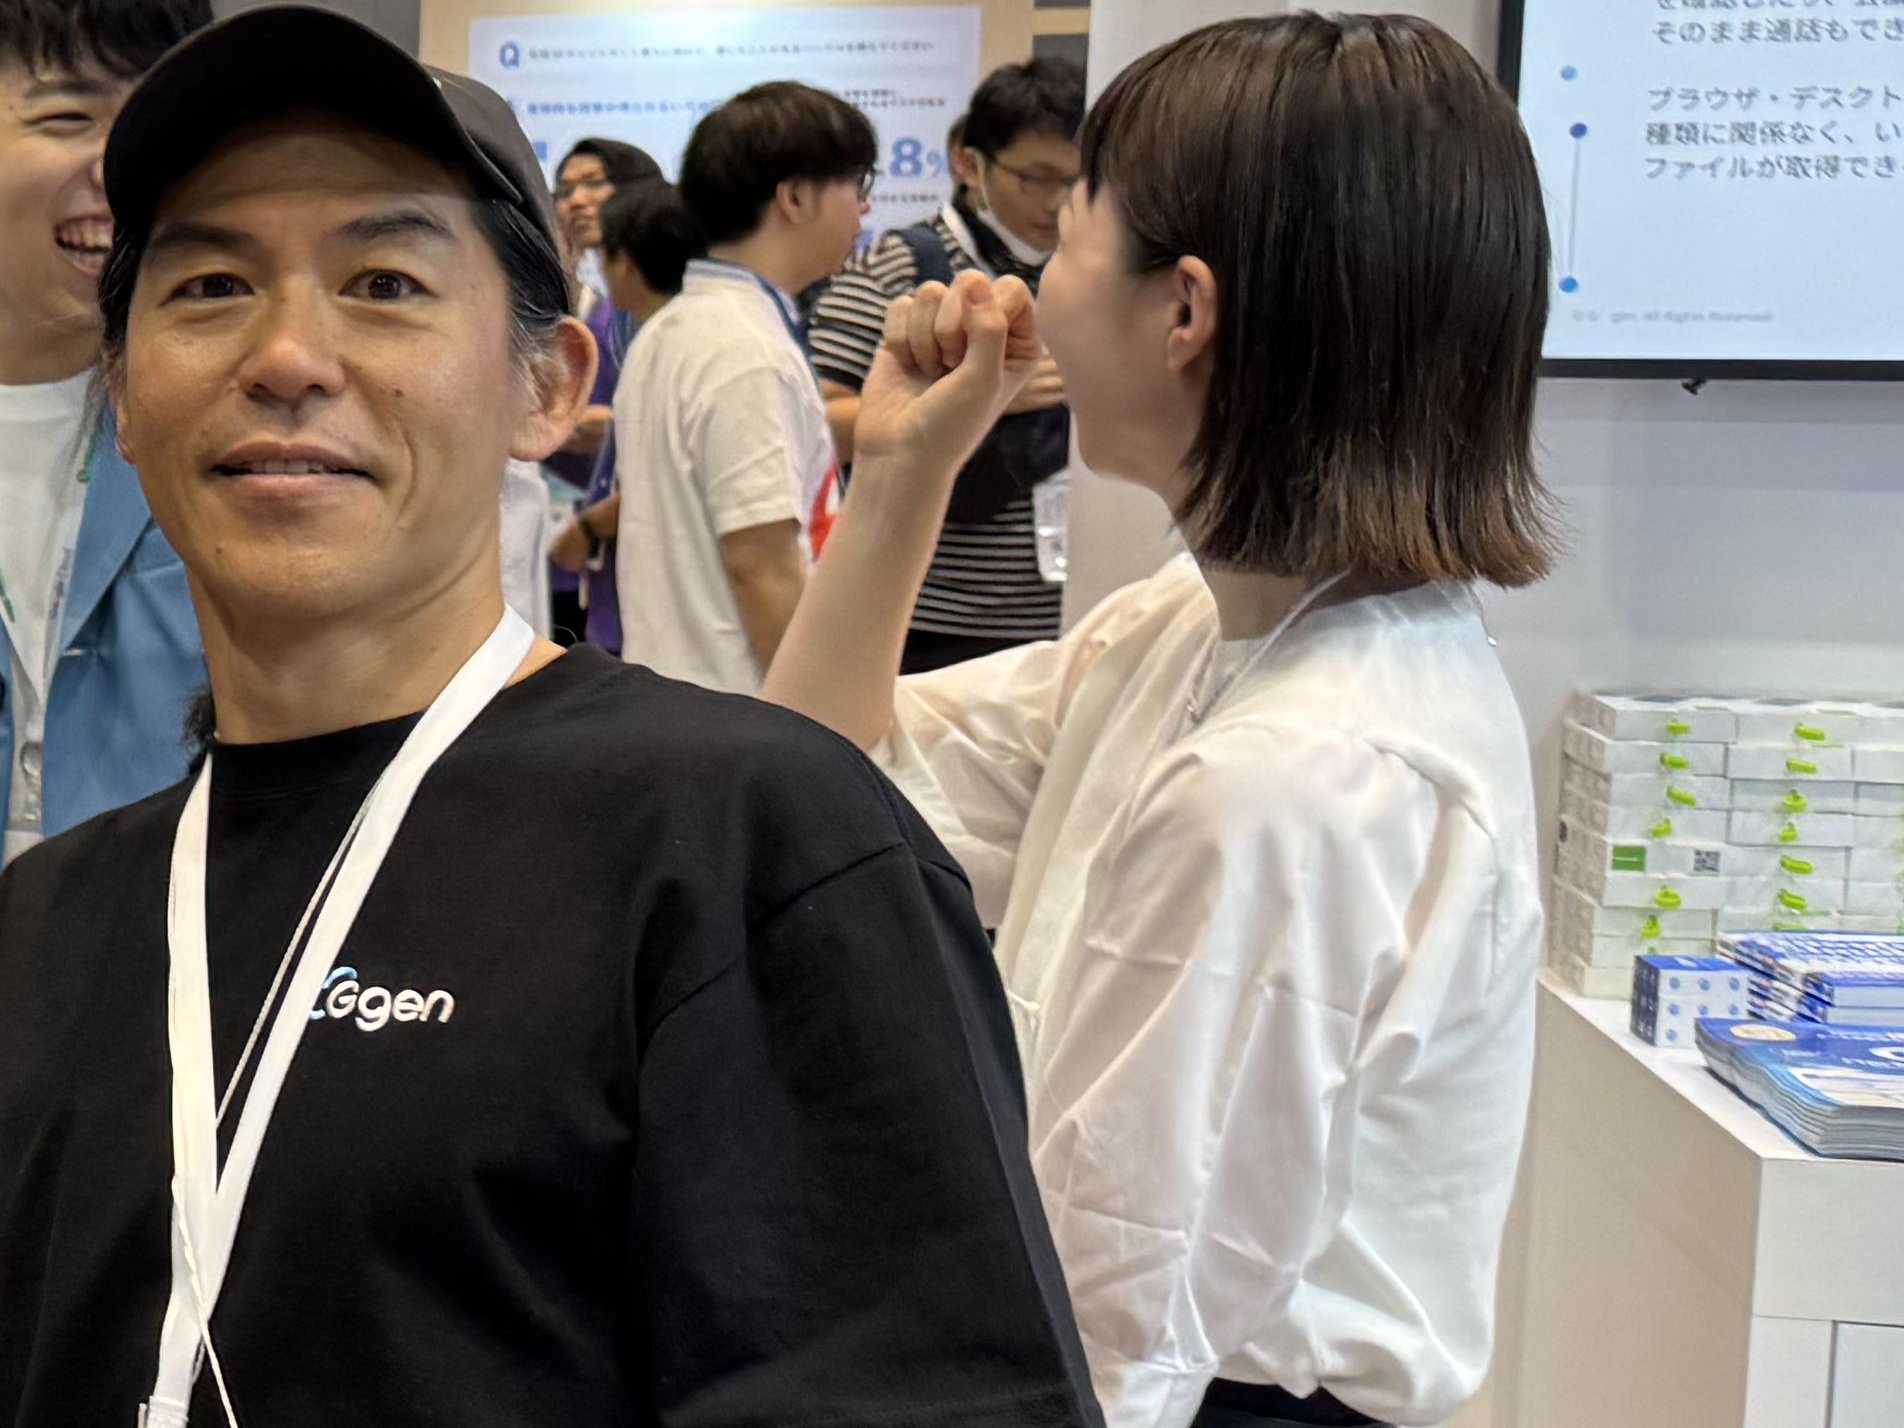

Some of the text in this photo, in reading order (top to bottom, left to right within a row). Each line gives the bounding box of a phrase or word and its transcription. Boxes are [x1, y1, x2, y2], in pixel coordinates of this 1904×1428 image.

[1644, 154, 1904, 180] ファイルが取得でき
[326, 979, 455, 1033] Ggen
